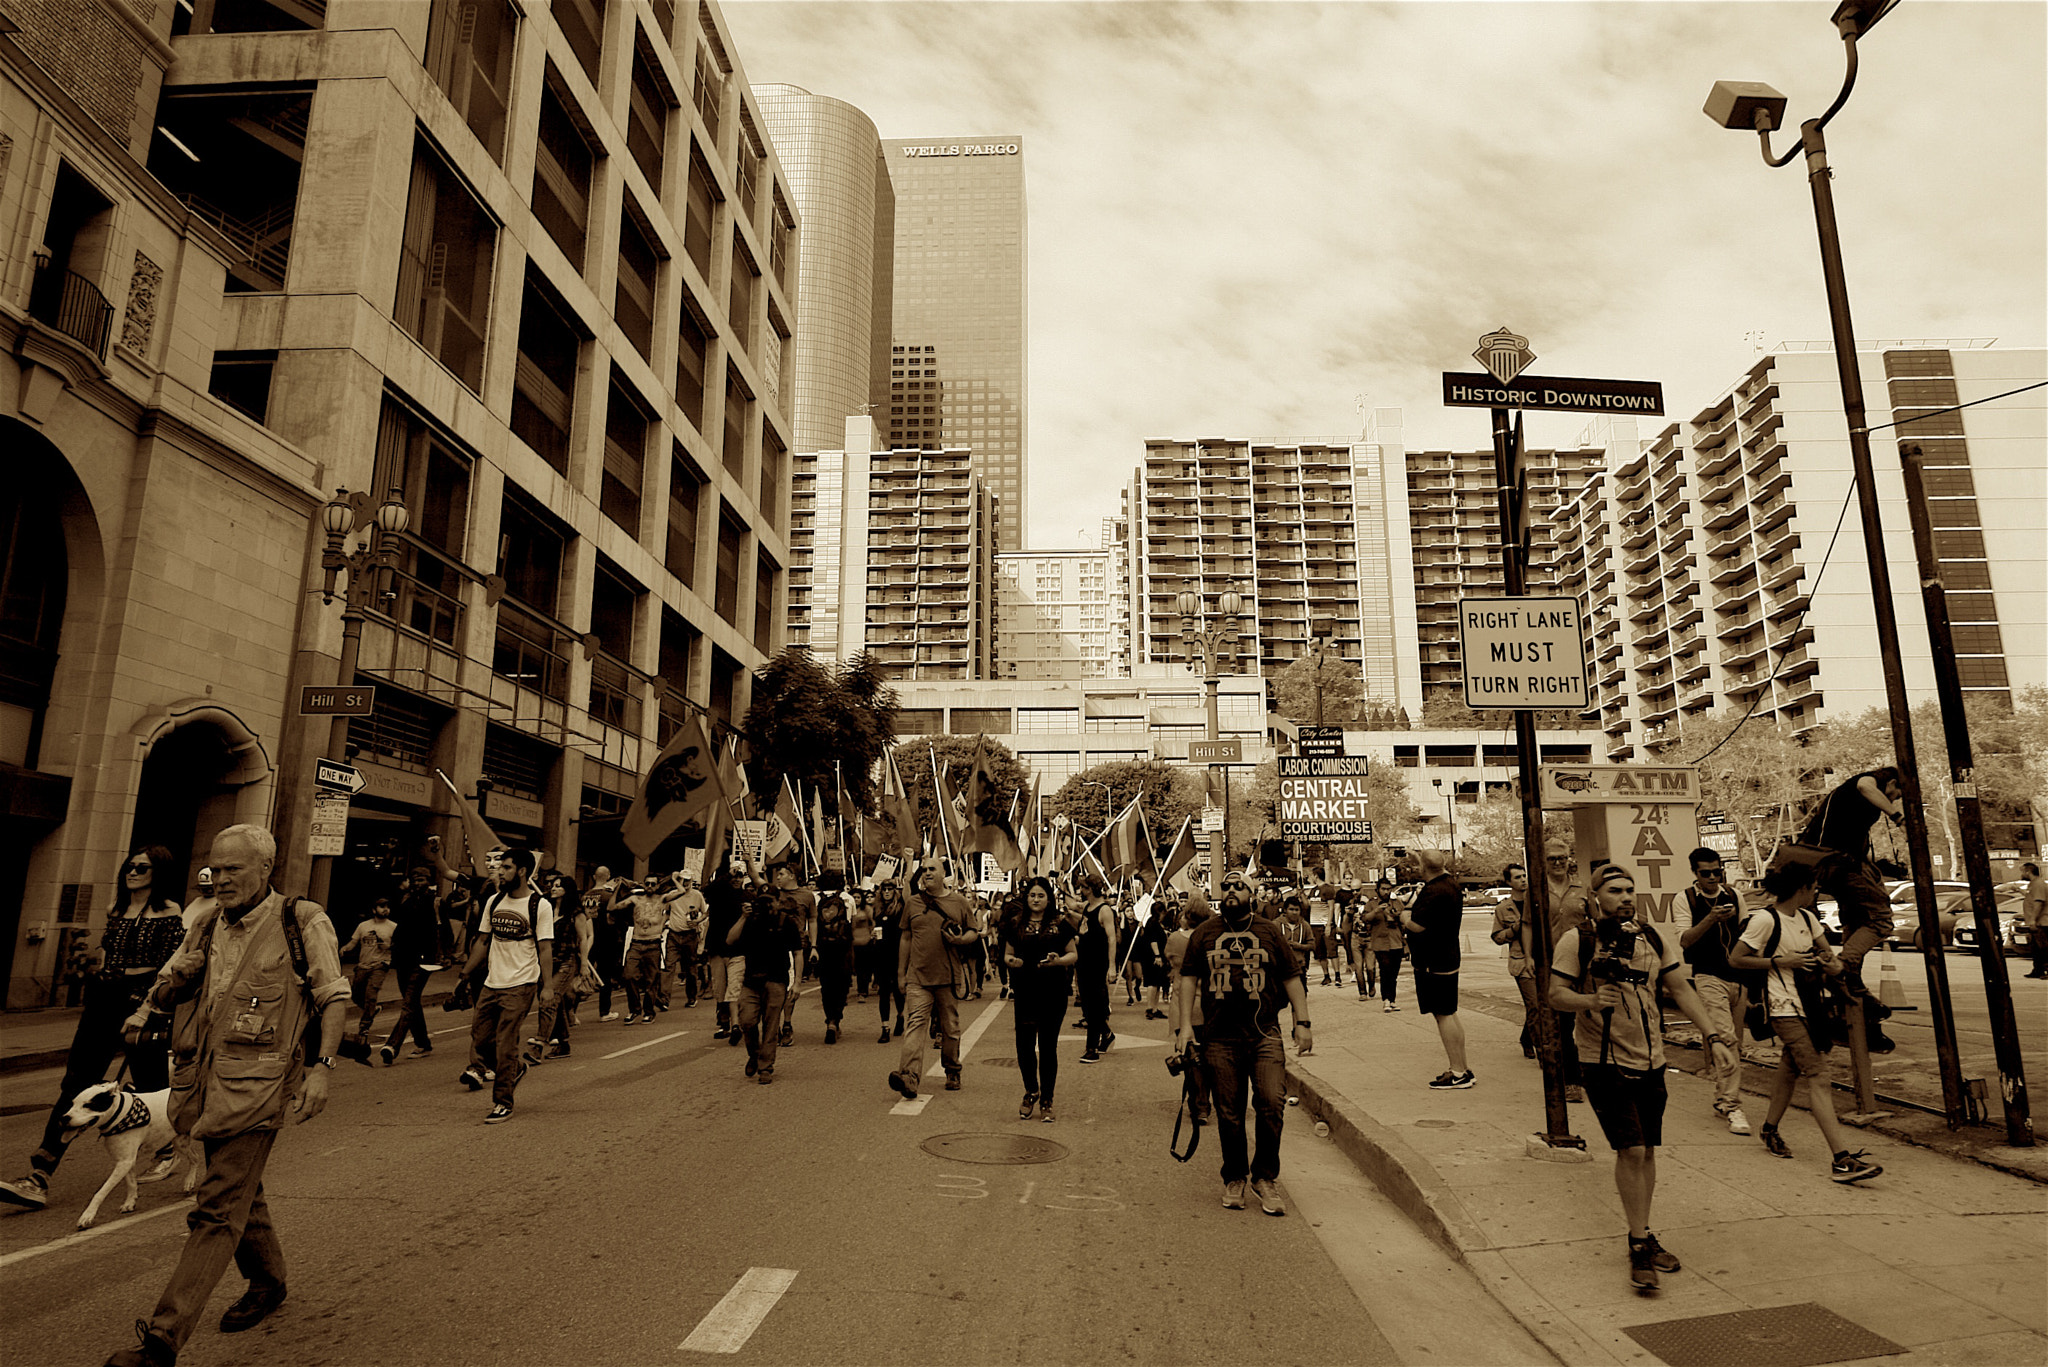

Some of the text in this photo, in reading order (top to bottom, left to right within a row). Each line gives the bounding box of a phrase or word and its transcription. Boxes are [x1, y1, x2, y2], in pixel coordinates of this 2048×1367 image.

[902, 143, 1019, 157] WELLS FARGO
[1468, 612, 1573, 628] RIGHT LANE
[1490, 642, 1554, 662] MUST
[1471, 677, 1580, 693] TURN RIGHT
[310, 694, 363, 707] Hill St
[1300, 728, 1342, 739] City Center
[1195, 746, 1235, 757] Hill St
[1279, 757, 1367, 776] LABOR COMMISSION
[321, 768, 353, 785] ONE WAY
[1612, 772, 1689, 790] ATM
[1280, 779, 1368, 799] CENTRAL
[1281, 800, 1368, 819] MARKET
[1630, 804, 1663, 825] 24
[1283, 821, 1371, 834] COURTHOUSE
[1631, 826, 1676, 923] ATM
[492, 917, 521, 926] DUMP
